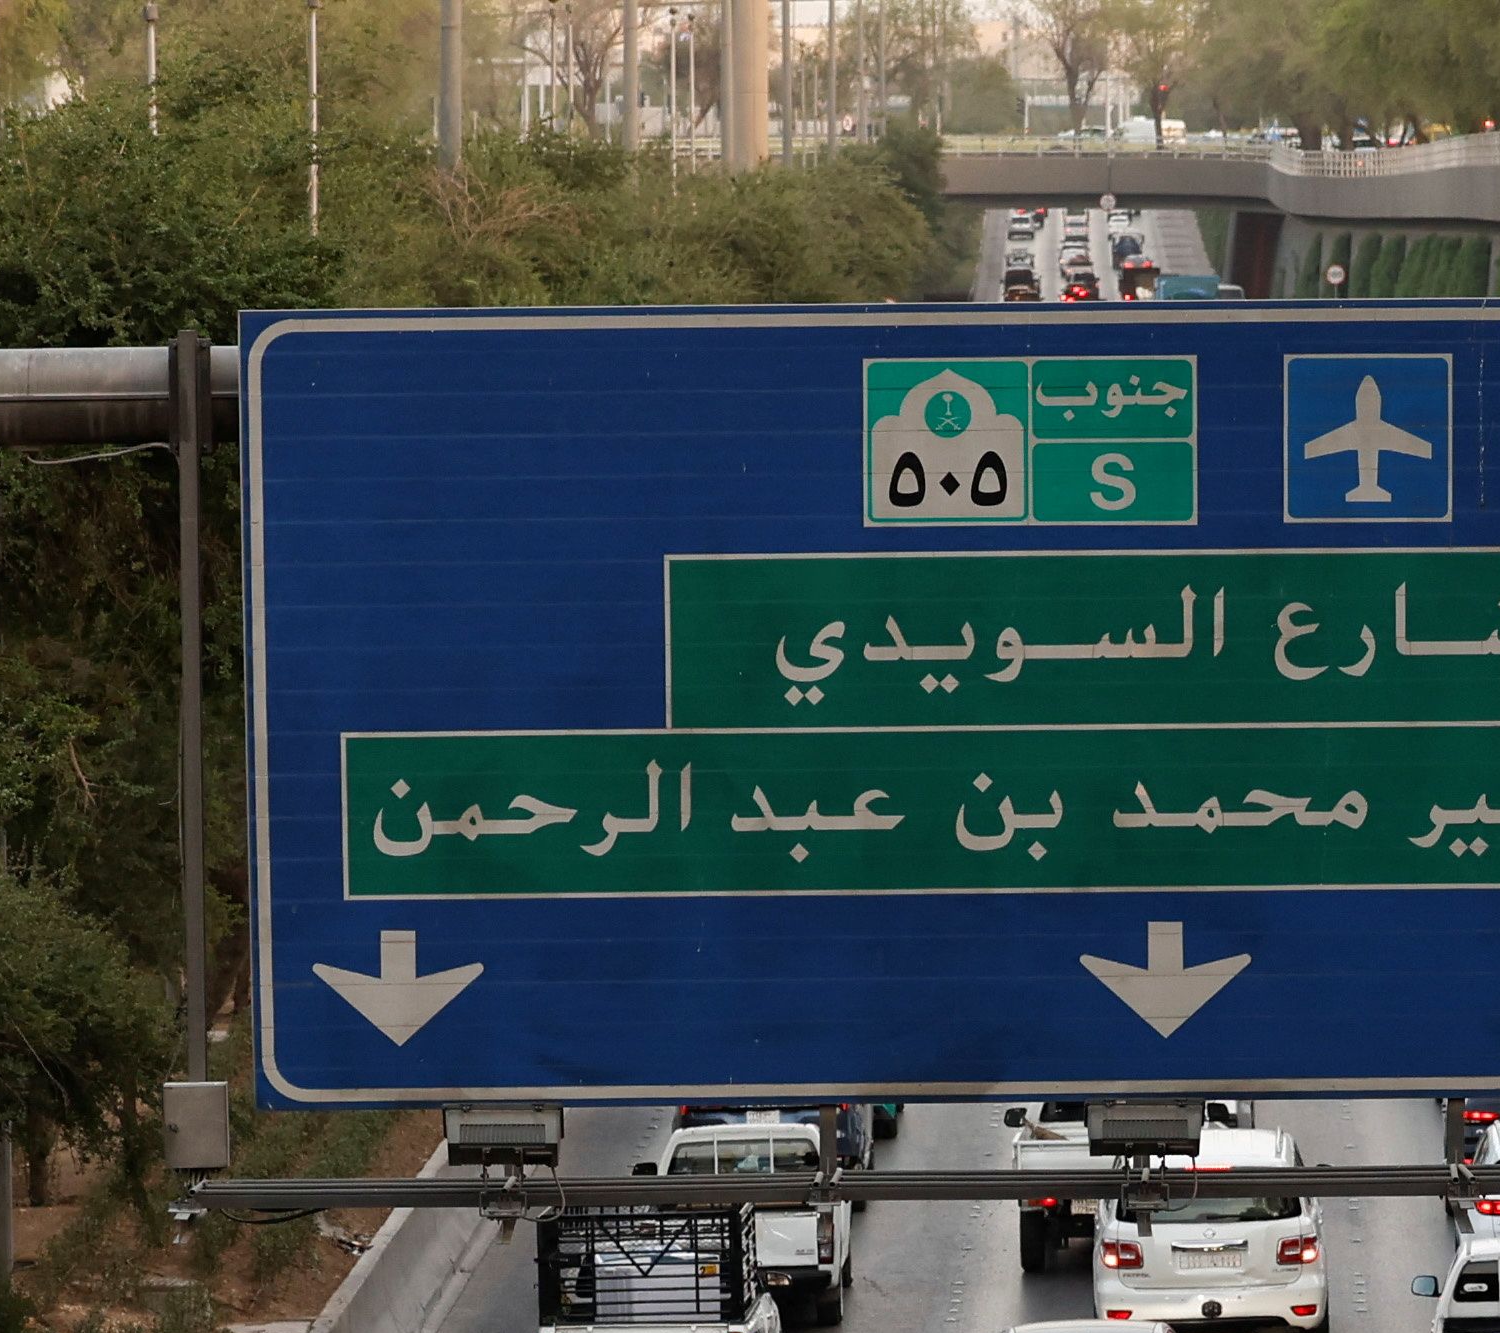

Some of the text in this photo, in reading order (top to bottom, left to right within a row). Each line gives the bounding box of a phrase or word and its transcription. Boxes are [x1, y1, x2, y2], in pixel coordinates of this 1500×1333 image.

[1037, 376, 1187, 420] جنوب
[889, 451, 1007, 507] ٥٠٥
[1091, 454, 1135, 510] S
[776, 585, 1223, 705] السويدي
[374, 760, 690, 856] الرحمن
[732, 786, 904, 862] عبد
[956, 779, 1062, 857] بن
[1114, 782, 1367, 833] محمد
